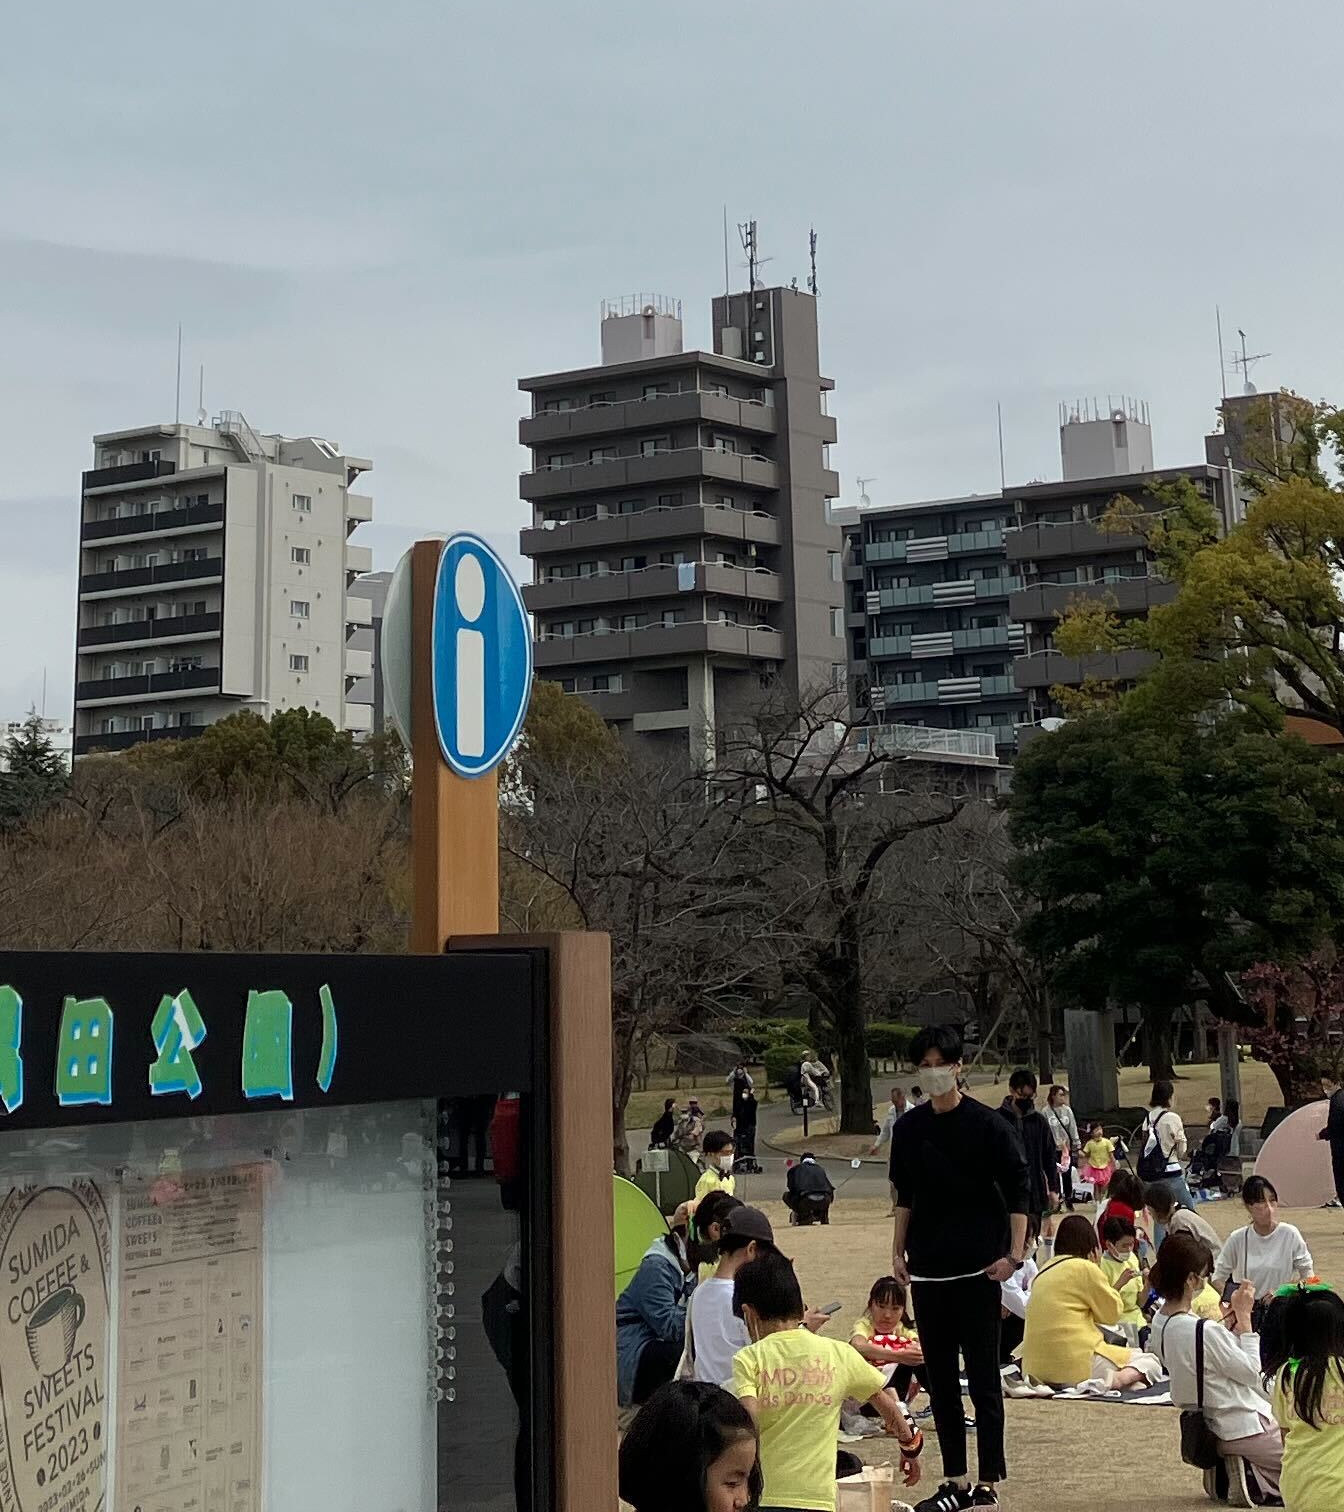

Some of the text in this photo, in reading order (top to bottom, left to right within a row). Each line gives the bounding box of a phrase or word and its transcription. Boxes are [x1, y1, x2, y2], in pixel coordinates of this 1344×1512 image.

[7, 1215, 82, 1285] SUMIDA
[7, 1252, 79, 1325] COFFEE
[23, 1343, 95, 1420] SWEETS
[22, 1377, 105, 1462] FESTIVAL
[47, 1428, 90, 1484] 2023
